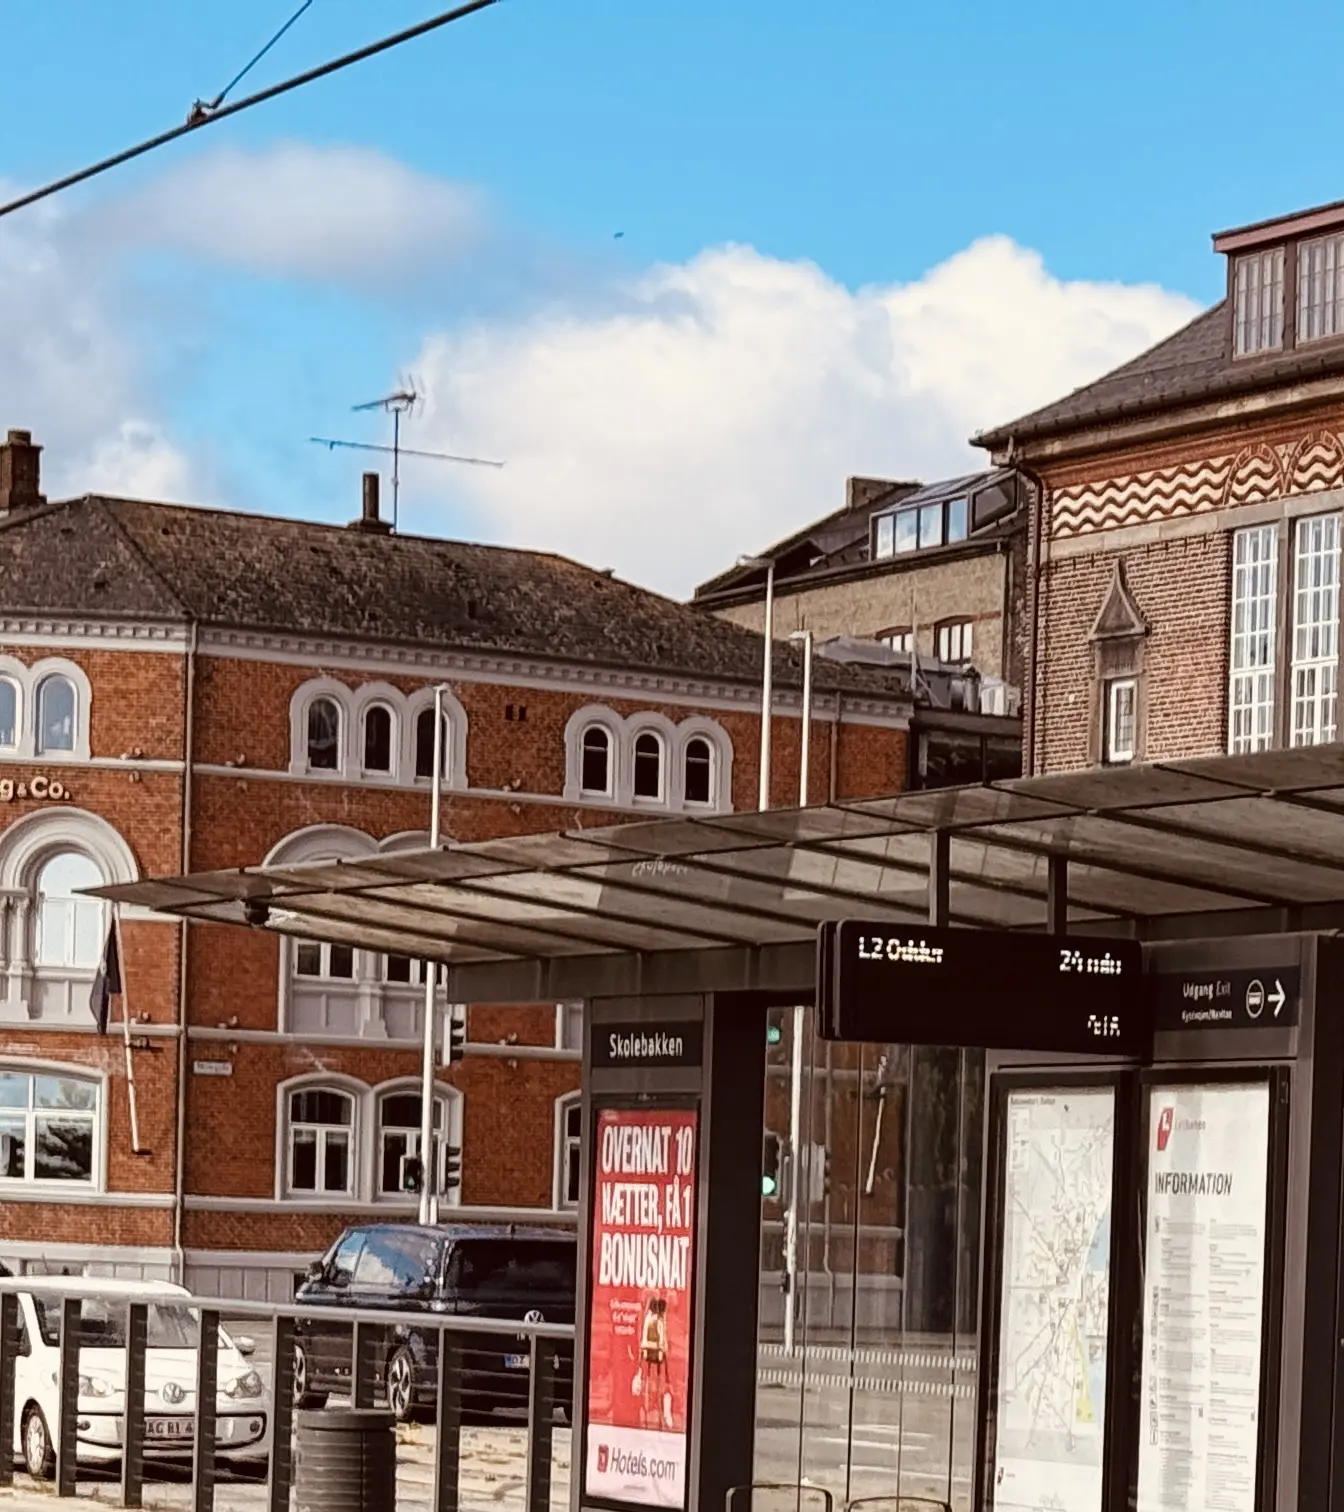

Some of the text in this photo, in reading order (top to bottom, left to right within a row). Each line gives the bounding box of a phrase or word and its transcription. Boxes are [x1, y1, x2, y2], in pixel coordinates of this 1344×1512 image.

[30, 776, 70, 799] Co.
[858, 936, 884, 959] L2
[1182, 981, 1214, 1001] Udgang
[609, 1031, 683, 1058] Skolebakken
[602, 1125, 693, 1175] OVERNAT 10
[1154, 1171, 1233, 1196] INFORMATION
[602, 1174, 692, 1233] NÆTTER, FÅ 1
[599, 1231, 690, 1290] BONUSNAT
[610, 1447, 677, 1481] Hotels.com
